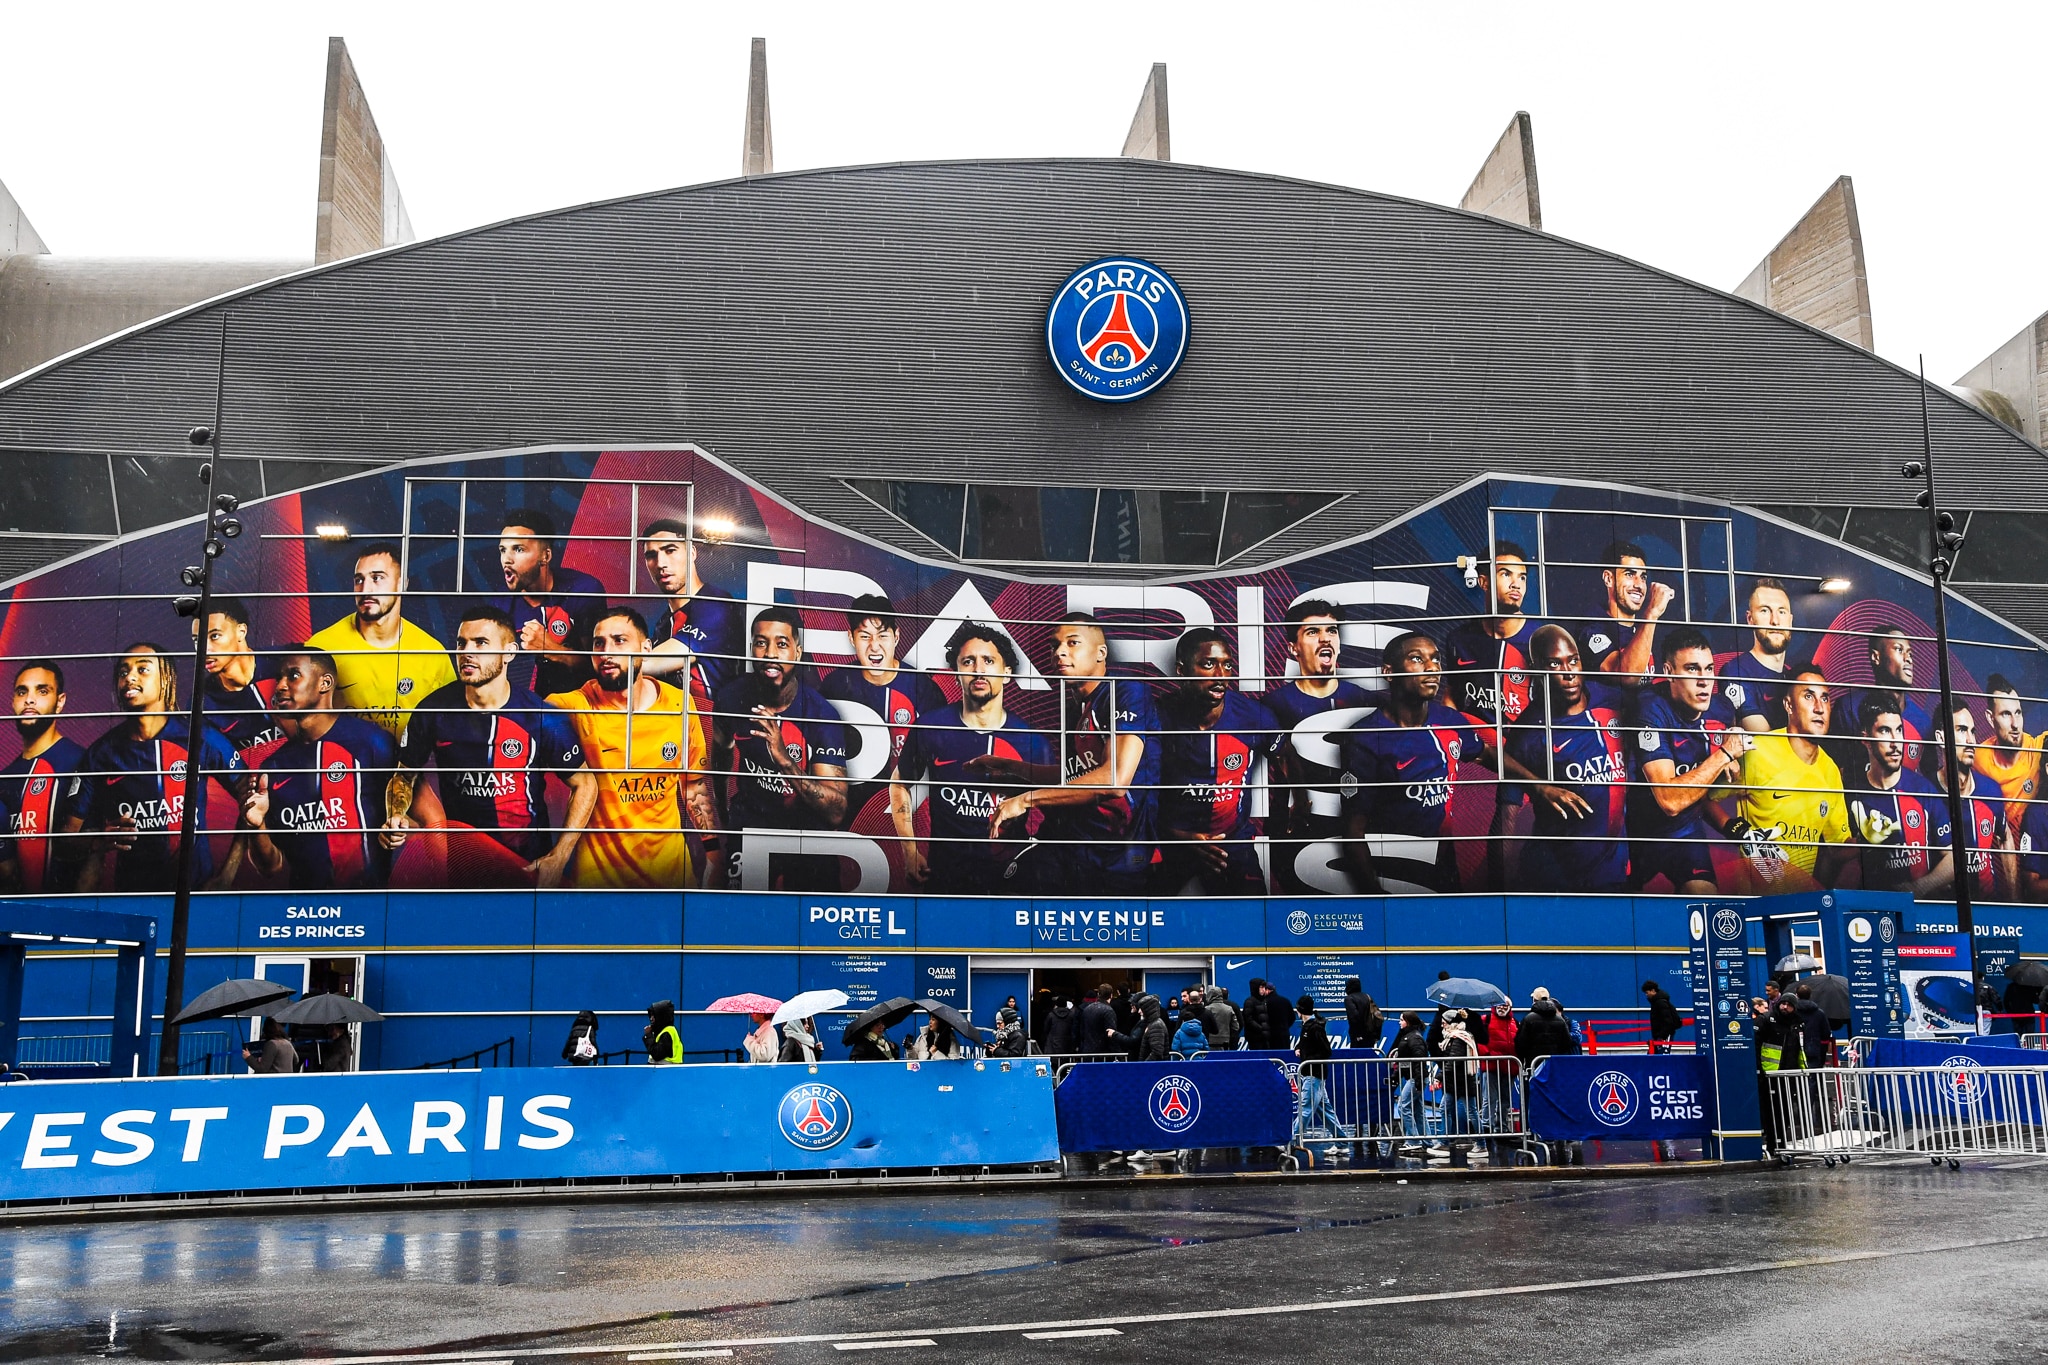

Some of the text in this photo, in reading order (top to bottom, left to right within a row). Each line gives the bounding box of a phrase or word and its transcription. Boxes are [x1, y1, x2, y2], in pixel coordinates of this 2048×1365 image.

[1075, 269, 1165, 303] PARIS
[1070, 360, 1100, 385] SAINT
[1109, 363, 1159, 388] GERMAIN
[1566, 752, 1625, 781] QATAR
[281, 797, 346, 828] QATAR
[297, 815, 348, 831] AIRWAYS
[286, 906, 341, 919] SALON
[1015, 910, 1165, 926] BIENVENUE
[810, 907, 906, 935] PORTE L
[1340, 921, 1363, 929] QATAR
[259, 925, 365, 938] DES PRINCES
[839, 925, 881, 939] GATE
[1038, 928, 1141, 942] WELCOME
[1855, 923, 1866, 937] L
[1974, 925, 1990, 937] DU
[1993, 926, 2023, 937] PARC
[928, 967, 956, 976] QATAR
[928, 989, 956, 997] GOAT
[1157, 1078, 1192, 1092] PARIS
[1595, 1073, 1629, 1087] PARIS
[1648, 1075, 1670, 1089] ICI
[790, 1086, 838, 1103] PARIS
[1649, 1090, 1698, 1104] C'EST
[1650, 1105, 1704, 1120] PARIS
[263, 1093, 575, 1160] PARIS
[791, 1130, 809, 1143] SAINT
[813, 1130, 839, 1145] GERMAIN
